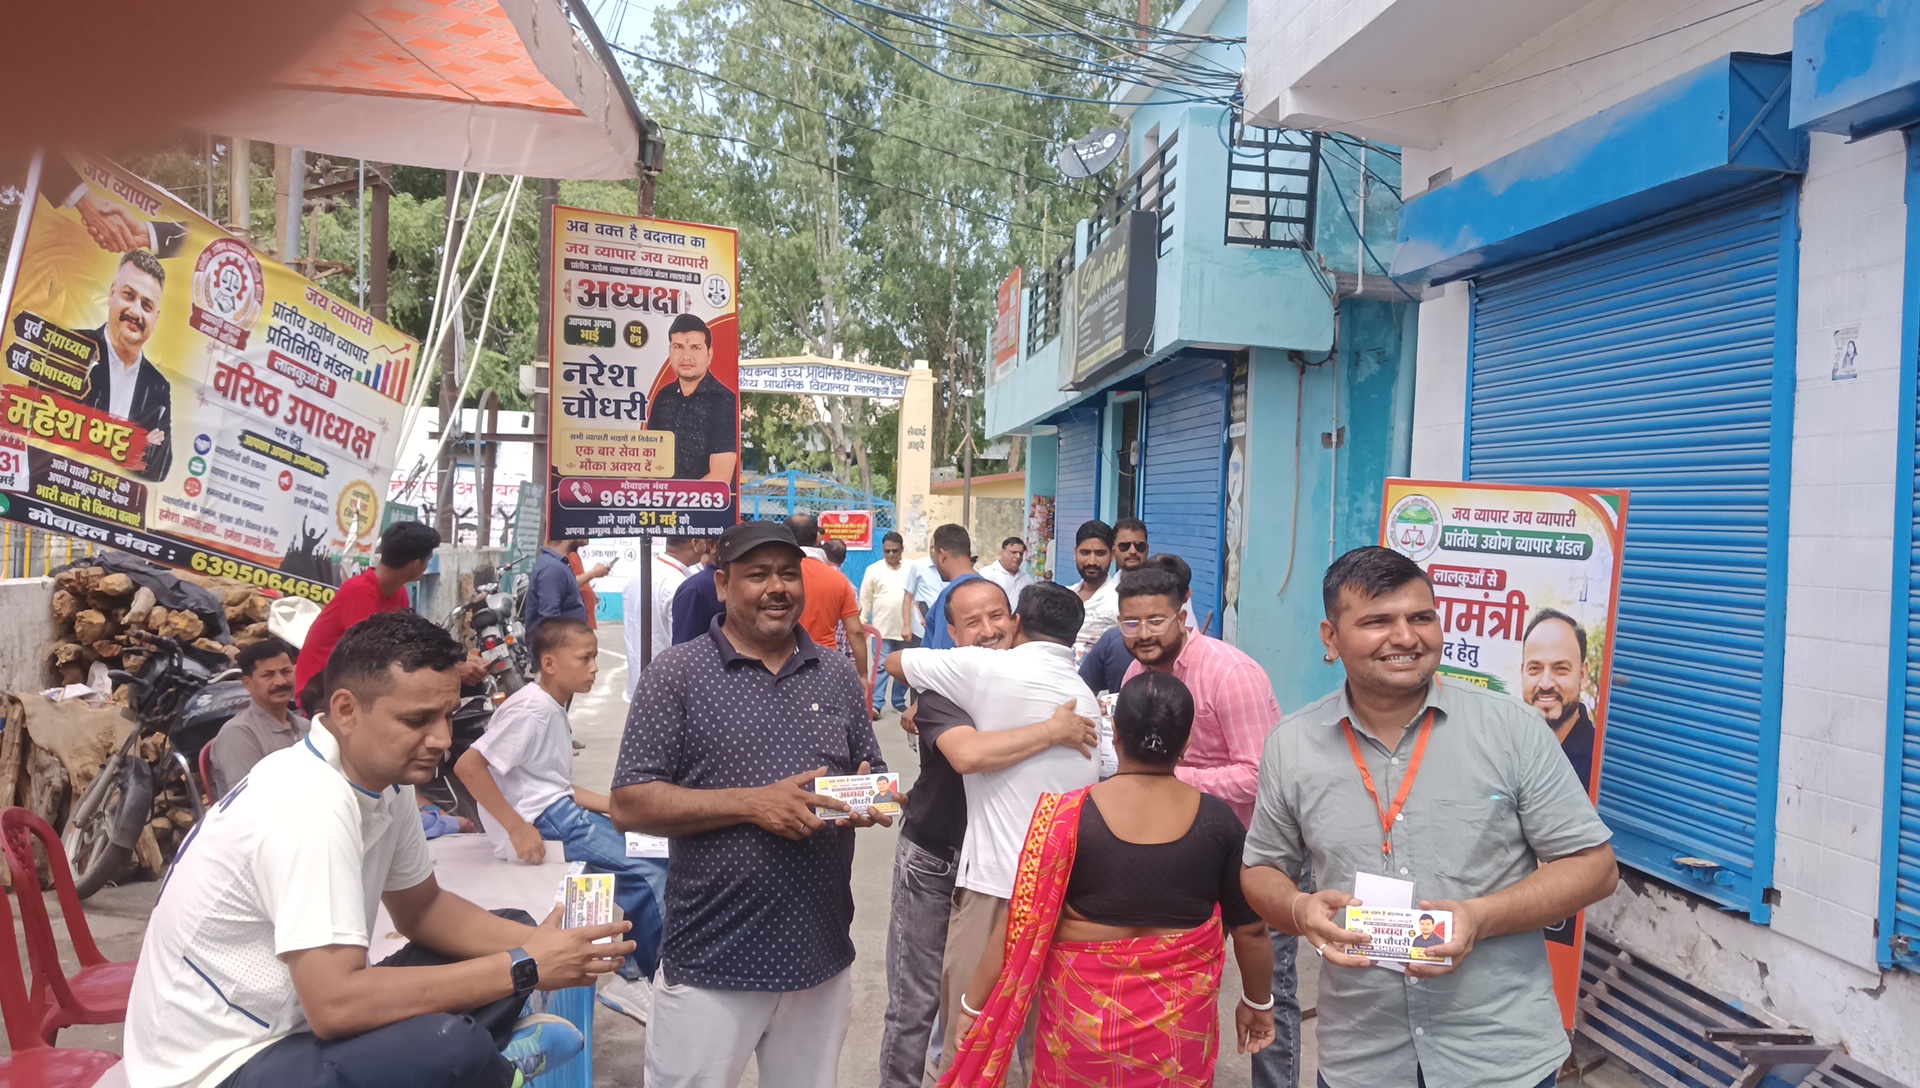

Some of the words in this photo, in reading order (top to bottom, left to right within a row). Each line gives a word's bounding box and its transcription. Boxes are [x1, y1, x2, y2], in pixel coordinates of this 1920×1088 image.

[84, 161, 111, 189] जय
[112, 174, 162, 217] व्यापार
[566, 219, 590, 234] अब
[595, 222, 624, 238] वक्त
[630, 223, 638, 241] है
[643, 229, 686, 246] बदलाव
[690, 235, 706, 249] का
[565, 242, 589, 255] जय
[595, 245, 637, 260] व्यापार
[641, 251, 663, 264] जय
[667, 254, 709, 270] व्यापारी
[577, 278, 680, 315] अध्यक्ष
[305, 286, 329, 311] जय
[331, 300, 374, 336] व्यापारी
[568, 317, 592, 327] आपका
[593, 319, 612, 329] अपना
[24, 318, 44, 341] पूर्व
[42, 329, 91, 360] उपाध्यक्ष
[272, 301, 306, 332] प्रांतीय
[308, 322, 336, 347] उद्योग
[337, 335, 370, 365] व्यापार
[580, 328, 600, 342] भाई
[630, 325, 642, 334] पद
[630, 334, 642, 346] हेतु
[266, 325, 323, 367] प्रतिनिधि
[323, 353, 354, 383] मंडल
[12, 350, 30, 370] पूर्व
[29, 357, 84, 392] कोषाध्यक्ष
[562, 353, 638, 388] नरेश
[755, 367, 778, 378] कन्या
[780, 366, 803, 379] उच्च
[806, 365, 843, 381] प्राथमिक
[844, 367, 876, 384] विद्यालय
[319, 374, 331, 393] से
[764, 378, 804, 390] प्राथमिक
[809, 379, 850, 392] विद्यालय
[213, 361, 283, 418] वरिष्ठ
[283, 393, 376, 460] उपाध्यक्ष
[561, 387, 648, 421] चौधरी
[7, 393, 86, 441] महेश
[88, 417, 133, 462] भट्ट
[275, 426, 287, 440] पद
[290, 431, 303, 450] हेतु
[570, 432, 583, 441] सभी
[585, 432, 608, 442] व्यापारी
[631, 434, 636, 443] से
[659, 435, 664, 444] है
[0, 452, 20, 473] 31
[575, 445, 594, 456] एक
[598, 446, 615, 457] बार
[619, 443, 639, 457] सेवा
[642, 447, 656, 457] का
[51, 458, 68, 471] आने
[69, 464, 90, 480] वाली
[89, 470, 103, 481] 31
[103, 474, 119, 491] मई
[118, 481, 131, 493] को
[579, 458, 606, 471] मौका
[610, 461, 641, 472] अवश्य
[47, 472, 71, 487] अपना
[111, 493, 130, 506] देकर
[620, 480, 650, 490] मोबाइल
[652, 481, 669, 491] नंबर
[36, 484, 59, 502] भारी
[81, 496, 91, 513] से
[92, 500, 118, 520] विजय
[600, 490, 724, 508] 9634572263
[159, 508, 180, 525] हमेशा
[597, 513, 614, 525] आने
[617, 513, 637, 525] वाली
[639, 511, 656, 526] 31
[659, 511, 677, 527] मई
[678, 514, 690, 525] को
[1452, 507, 1471, 521] जय
[1474, 508, 1509, 523] व्यापार
[1513, 510, 1532, 524] जय
[1536, 509, 1577, 527] व्यापारी
[28, 506, 110, 542] मोबाइल
[114, 532, 163, 556] नंबर
[565, 527, 585, 535] अपना
[678, 526, 685, 535] से
[1444, 529, 1478, 549] प्रांतीय
[1481, 531, 1512, 551] उद्योग
[1515, 536, 1552, 554] व्यापार
[1555, 535, 1585, 556] मंडल
[191, 551, 335, 605] 6395064650
[1433, 568, 1484, 588] लालकुआँ
[1487, 569, 1498, 587] से
[1435, 590, 1529, 641] ामंत्री
[1457, 637, 1480, 668] हेतु
[1372, 926, 1403, 937] अध्यक्ष
[1384, 936, 1410, 946] चौधरी
